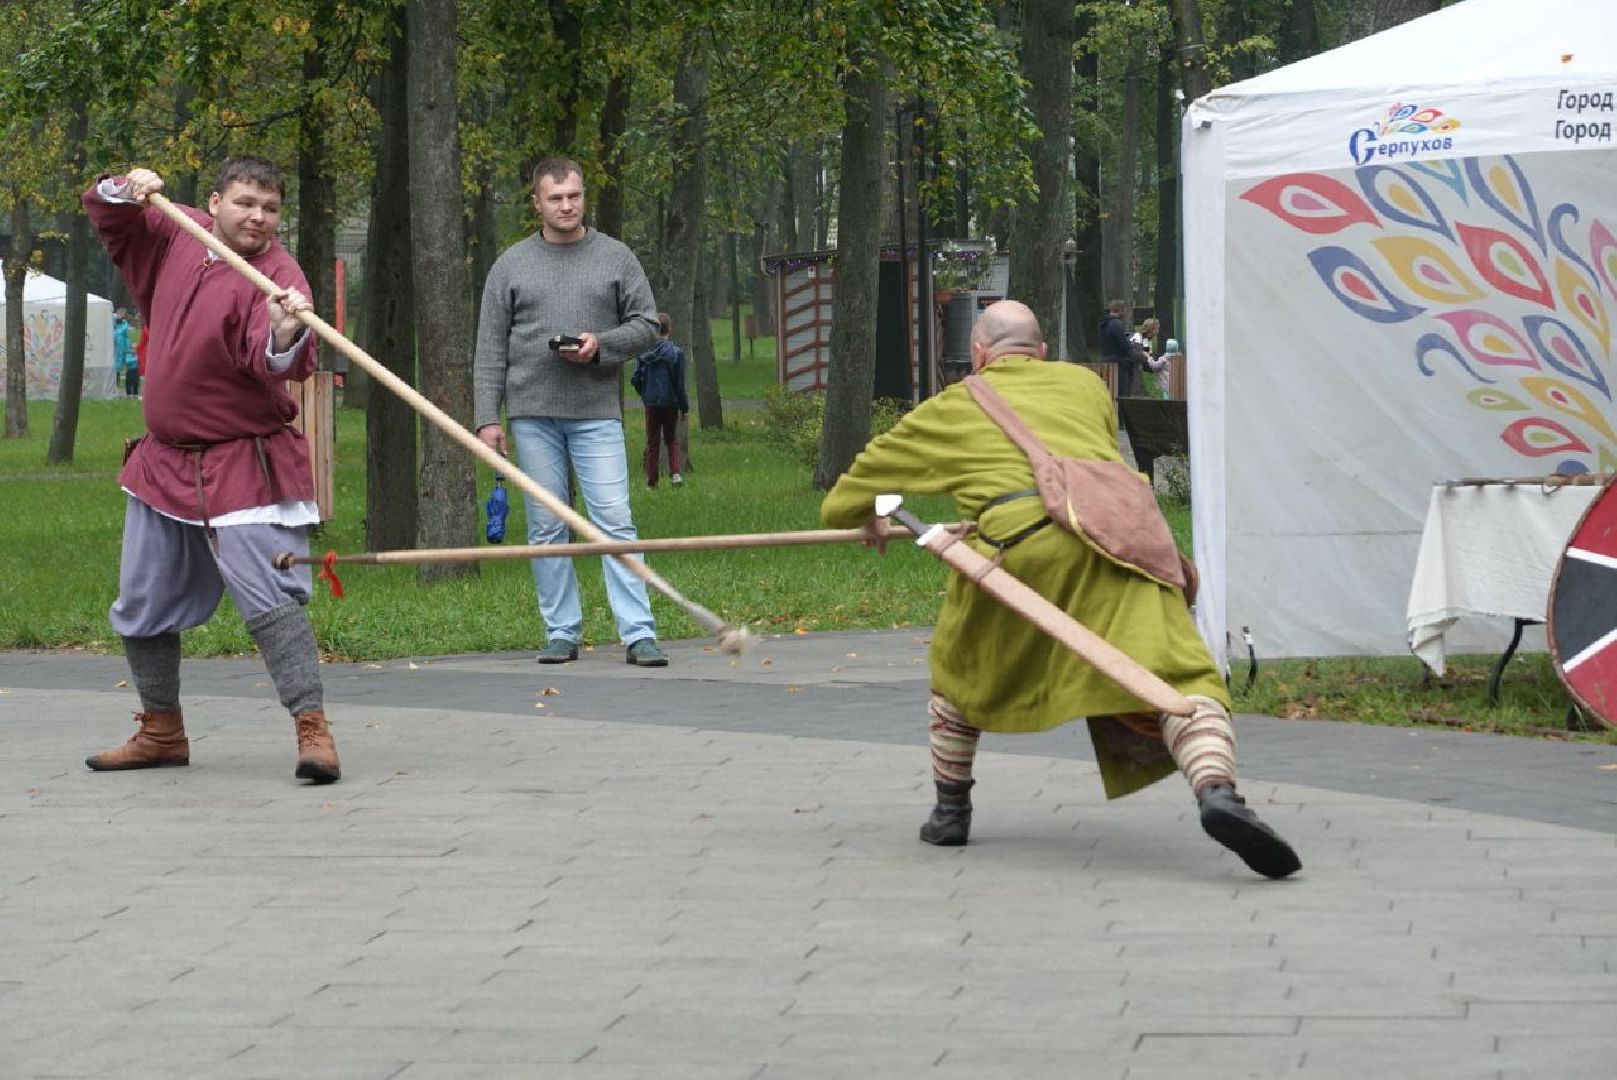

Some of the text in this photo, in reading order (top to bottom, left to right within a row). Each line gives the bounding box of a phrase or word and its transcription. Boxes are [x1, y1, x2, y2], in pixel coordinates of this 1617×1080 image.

[1557, 89, 1614, 114] Город
[1555, 119, 1611, 144] Город
[1349, 128, 1453, 166] Серпухов
